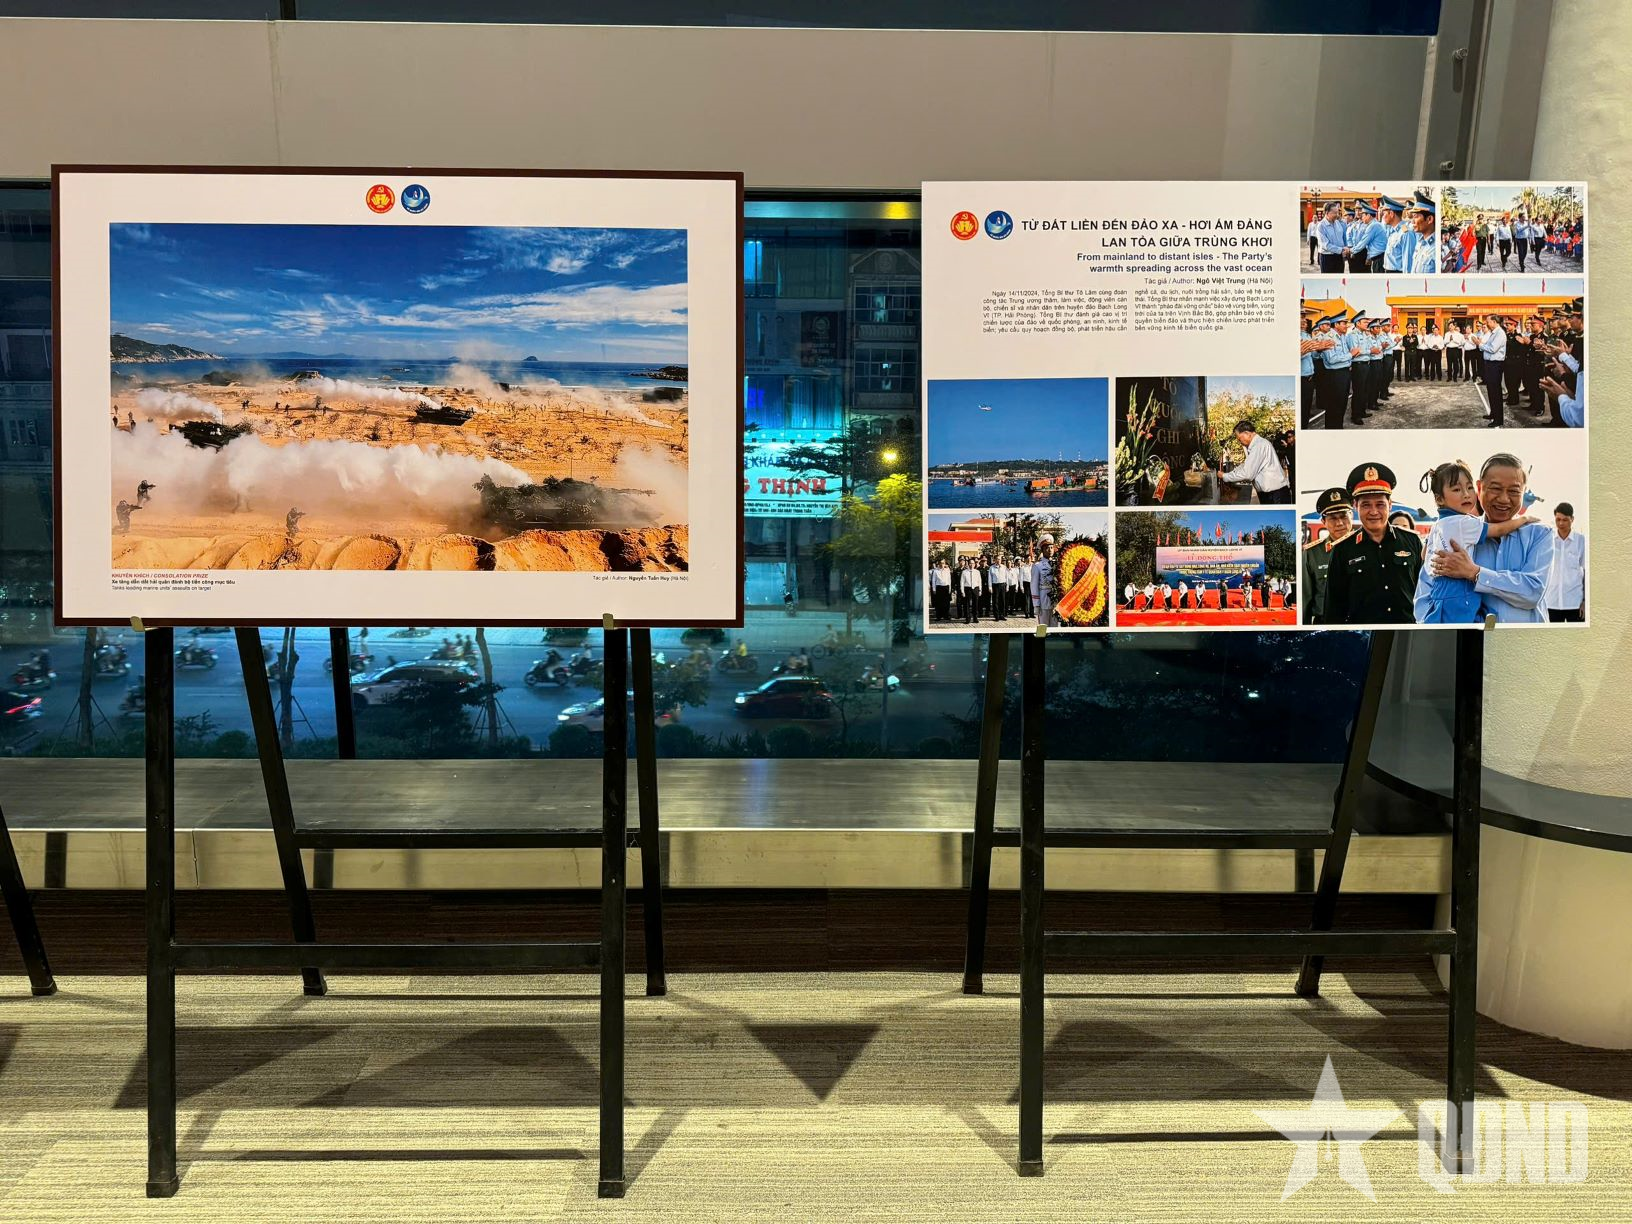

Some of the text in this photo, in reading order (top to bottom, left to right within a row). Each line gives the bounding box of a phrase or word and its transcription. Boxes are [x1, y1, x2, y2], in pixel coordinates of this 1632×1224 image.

[1022, 219, 1040, 231] TỪ
[1131, 219, 1158, 231] ĐẢO
[1162, 221, 1179, 231] XA
[1189, 221, 1212, 231] HƠI
[1237, 219, 1273, 230] ĐẢNG
[1102, 236, 1273, 248] LAN TỎA GIỮA TRÙNG KHƠI
[1241, 253, 1273, 263] Party's
[1126, 265, 1172, 274] spreading
[1157, 428, 1180, 444] GHI
[758, 478, 826, 498] THỊNH
